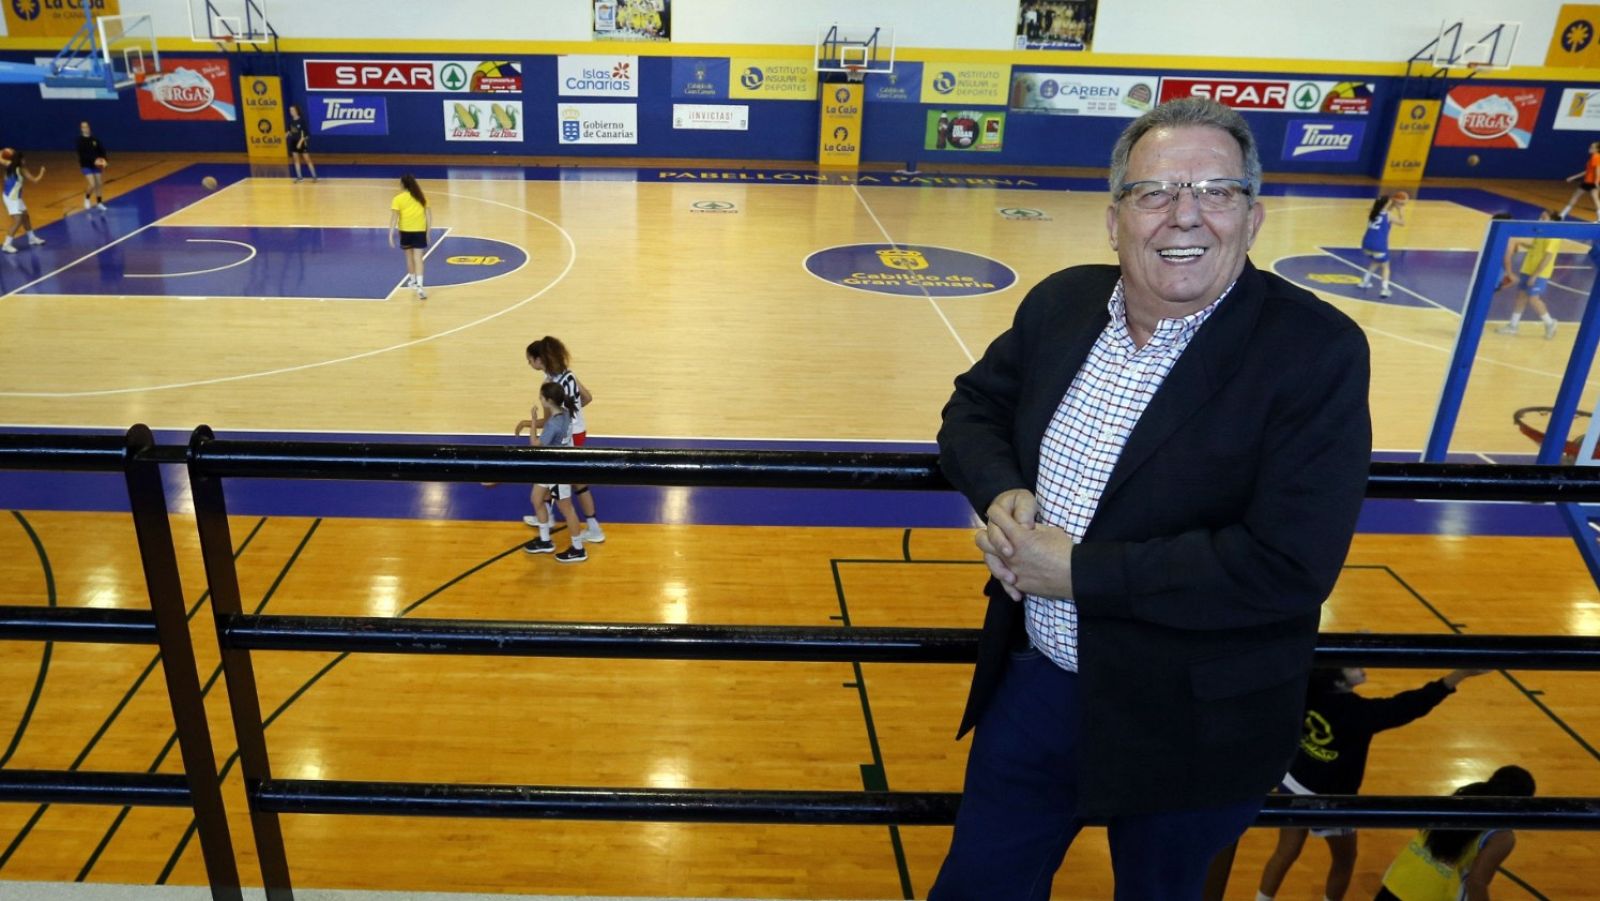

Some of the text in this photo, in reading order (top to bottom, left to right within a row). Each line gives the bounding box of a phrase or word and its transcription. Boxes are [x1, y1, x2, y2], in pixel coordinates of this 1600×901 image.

[335, 66, 432, 86] SPAR
[583, 68, 610, 79] Islas
[766, 66, 808, 74] INSTITUTO
[566, 77, 630, 90] Canarias
[1060, 85, 1120, 96] CARBEN
[1190, 84, 1287, 105] SPAR
[323, 98, 376, 119] Tirma
[583, 120, 624, 129] Gobierno
[1463, 113, 1513, 129] FIRGAS
[583, 130, 634, 138] de Canarias
[1302, 123, 1353, 146] Tirma
[840, 174, 880, 182] LA
[890, 175, 1038, 187] PATERNA
[843, 277, 995, 289] Gran Canaria
[851, 272, 974, 282] Cabildo de
